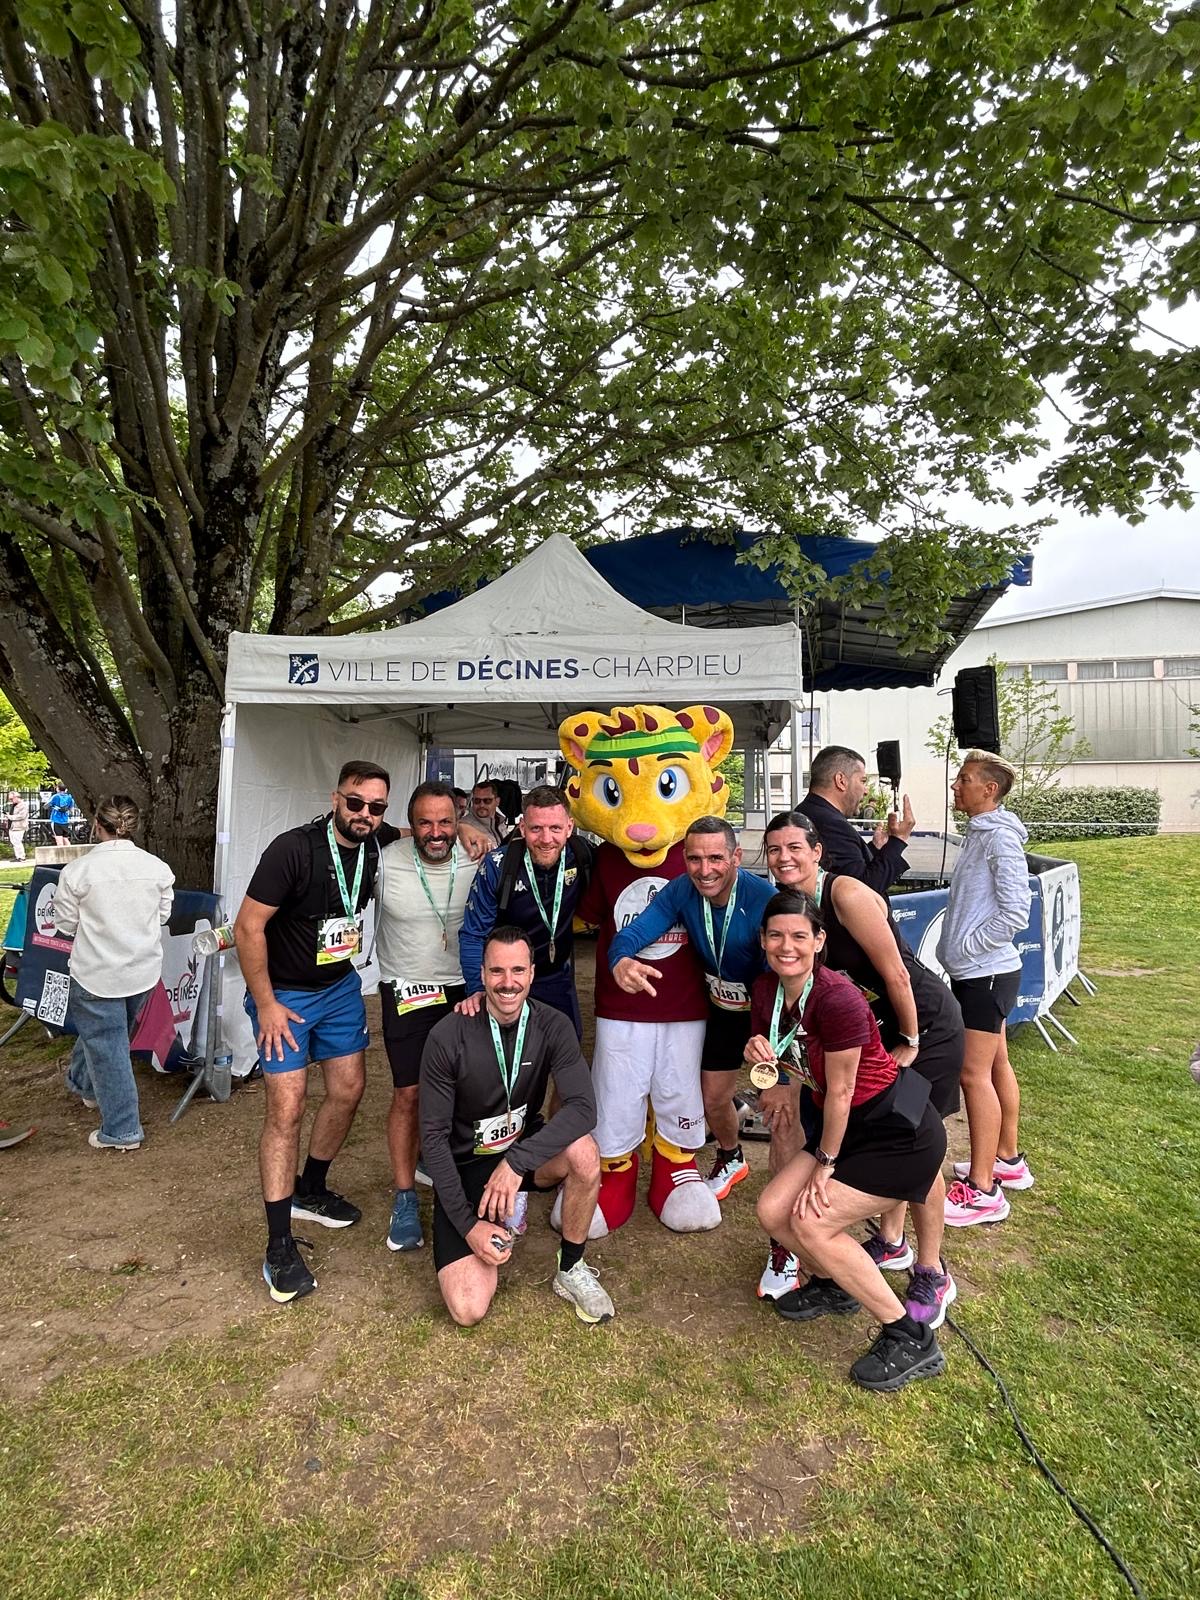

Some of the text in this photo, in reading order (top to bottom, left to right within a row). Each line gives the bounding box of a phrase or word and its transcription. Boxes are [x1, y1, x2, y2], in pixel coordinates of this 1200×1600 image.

[328, 654, 742, 682] VILLE DE DÉCINES-CHARPIEU
[657, 933, 684, 942] ATURE
